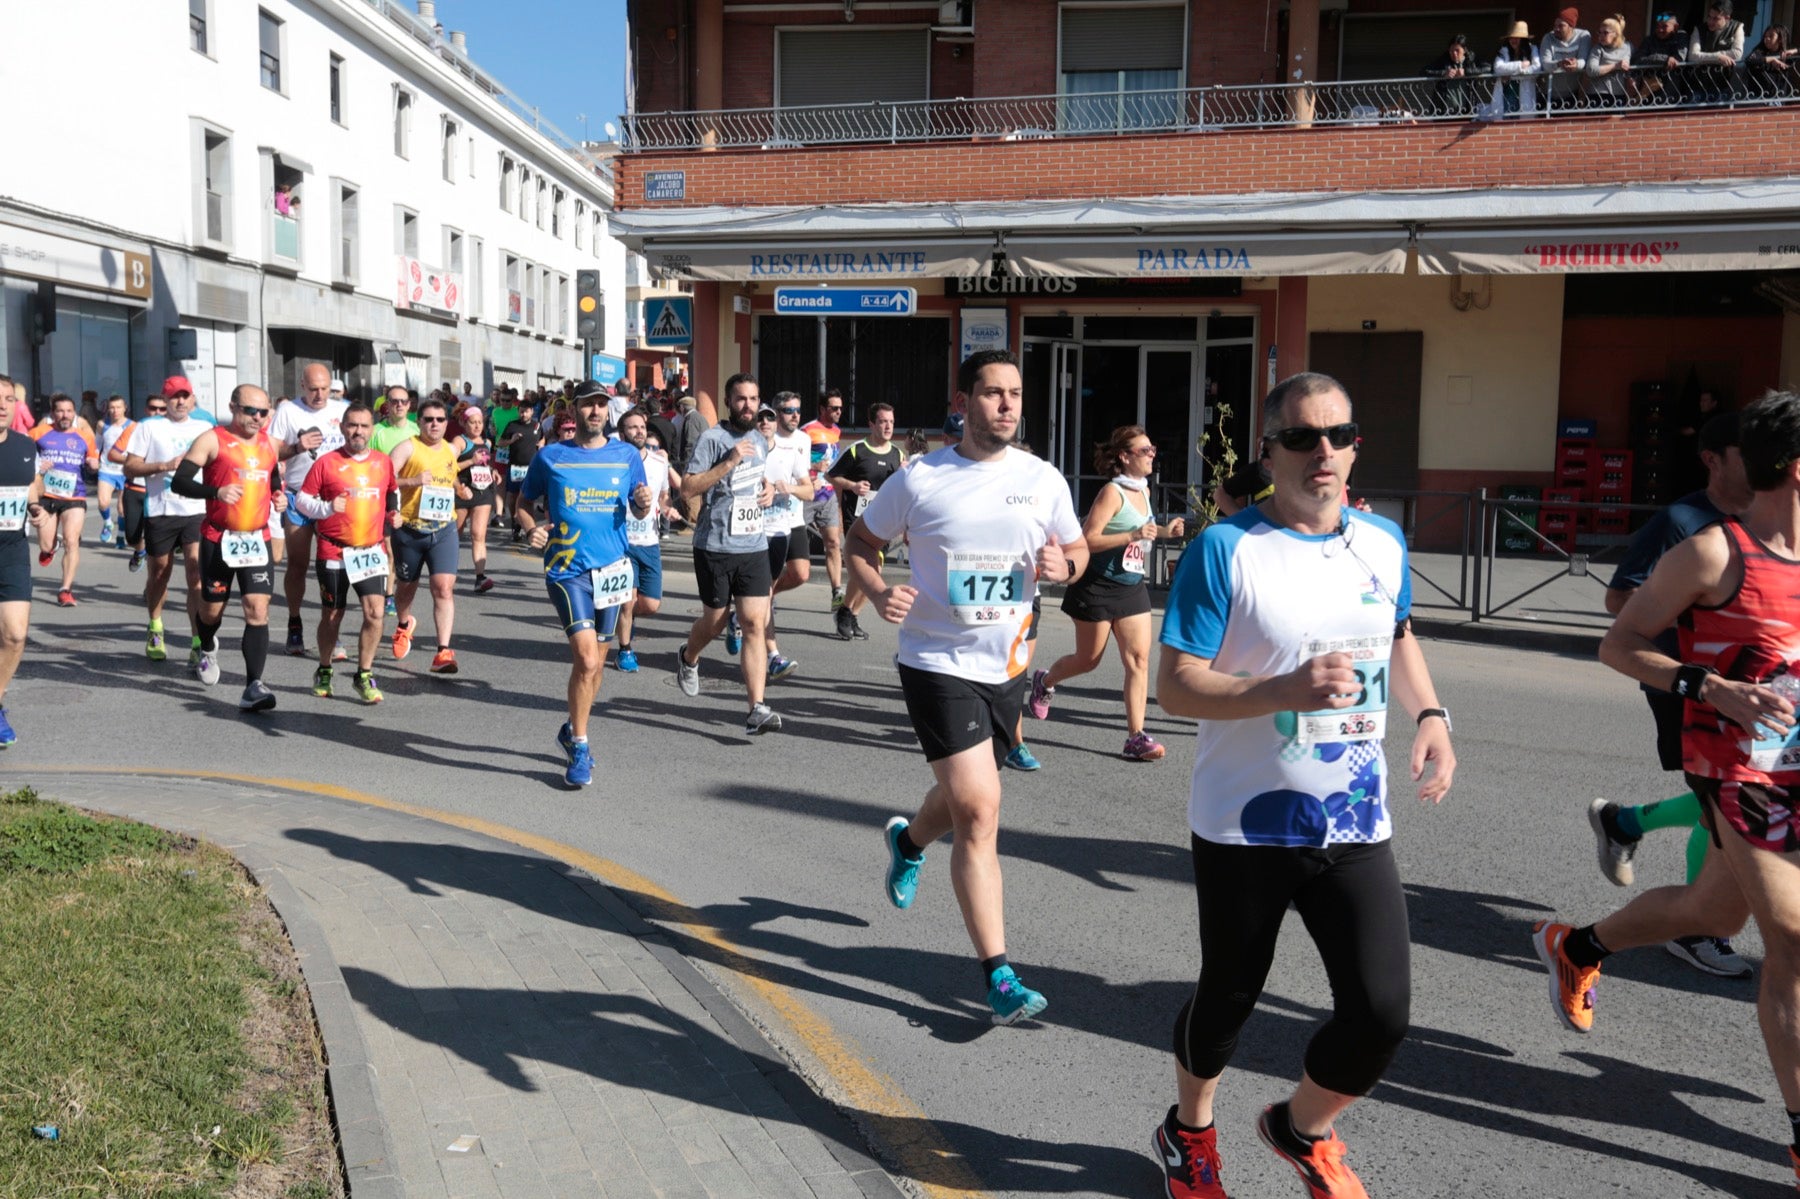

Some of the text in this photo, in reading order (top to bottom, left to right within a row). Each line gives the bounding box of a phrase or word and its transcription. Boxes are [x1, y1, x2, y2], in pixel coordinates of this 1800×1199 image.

[657, 180, 680, 188] JACOBO
[648, 189, 682, 198] CAMARERO
[15, 246, 45, 261] SHOP
[1136, 248, 1252, 271] PARADA
[751, 251, 926, 275] RESTAURANTE
[132, 260, 145, 289] B
[957, 276, 1077, 293] BICHITOS
[779, 295, 832, 307] Granada
[48, 476, 70, 489] 546
[579, 487, 619, 499] olimpo
[428, 497, 451, 511] 137
[229, 541, 260, 556] 294
[352, 553, 381, 569] 176
[601, 574, 628, 593] 422
[963, 575, 1014, 601] 173
[1345, 638, 1369, 648] PREMIO
